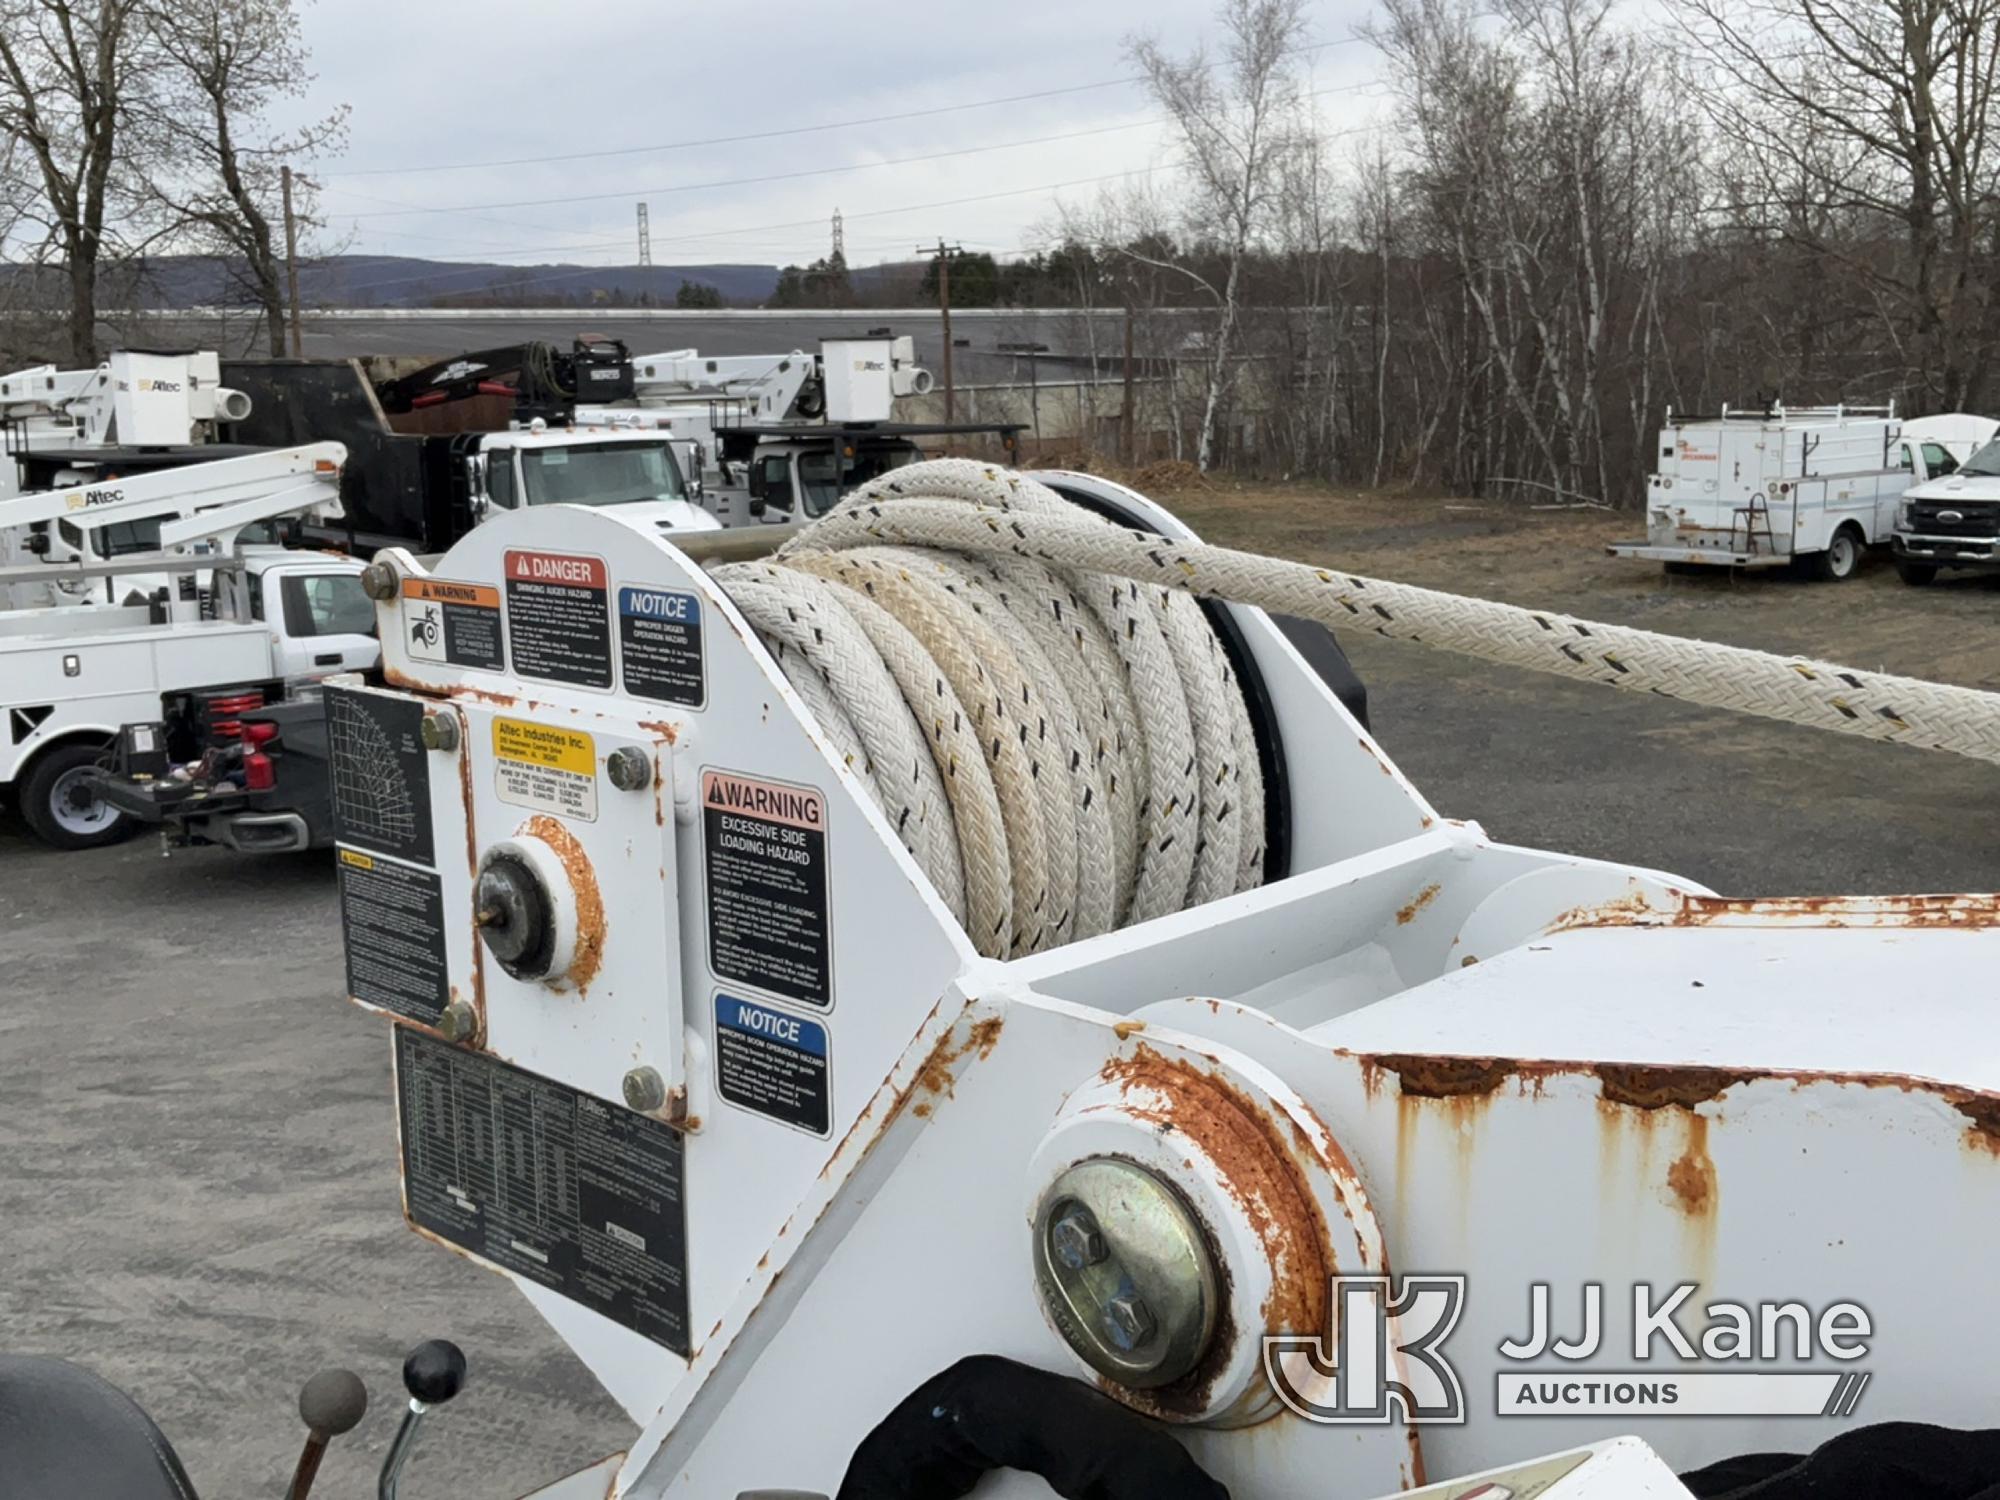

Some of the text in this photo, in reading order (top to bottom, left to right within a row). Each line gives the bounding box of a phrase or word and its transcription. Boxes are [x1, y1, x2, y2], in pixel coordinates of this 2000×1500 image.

[152, 380, 180, 392] Altec
[85, 489, 124, 507] Altec
[532, 558, 592, 583] DANGER
[432, 585, 477, 601] WARNING
[568, 589, 592, 600] HAZARD
[630, 592, 688, 618] NOTICE
[665, 636, 688, 645] HAZARD
[500, 723, 520, 736] Altec
[523, 728, 566, 746] Industries
[569, 736, 585, 749] Inc.
[725, 781, 819, 824] WARNING
[721, 816, 807, 847] EXCESSIVE SIDE
[720, 833, 810, 866] LOADING HAZARD
[738, 1005, 800, 1042] NOTICE
[800, 1054, 825, 1068] HAZARD
